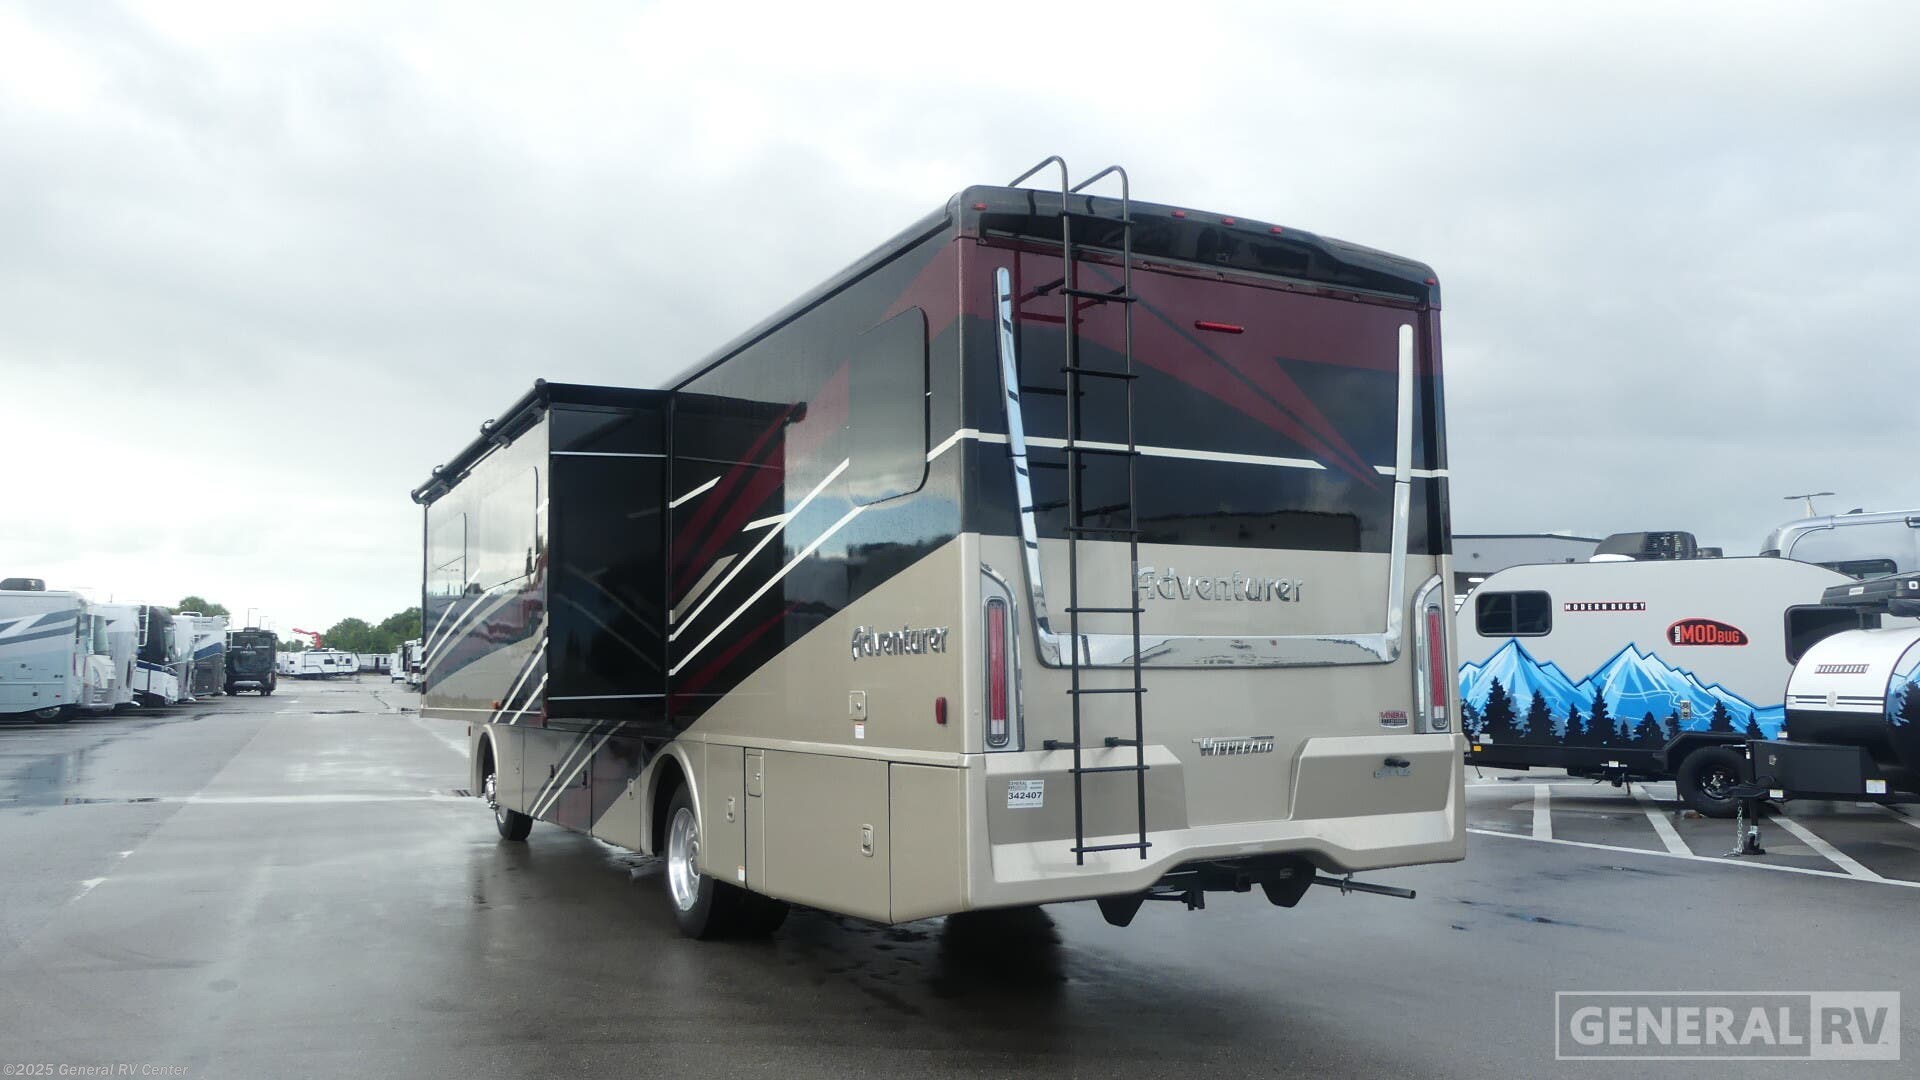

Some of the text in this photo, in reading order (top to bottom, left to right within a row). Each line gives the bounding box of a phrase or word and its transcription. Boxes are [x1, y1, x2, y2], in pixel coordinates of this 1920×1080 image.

[1136, 566, 1303, 602] Adventurer
[1565, 602, 1645, 611] MODERN BUGGY
[852, 625, 949, 661] Adventurer
[1008, 791, 1042, 800] 342407
